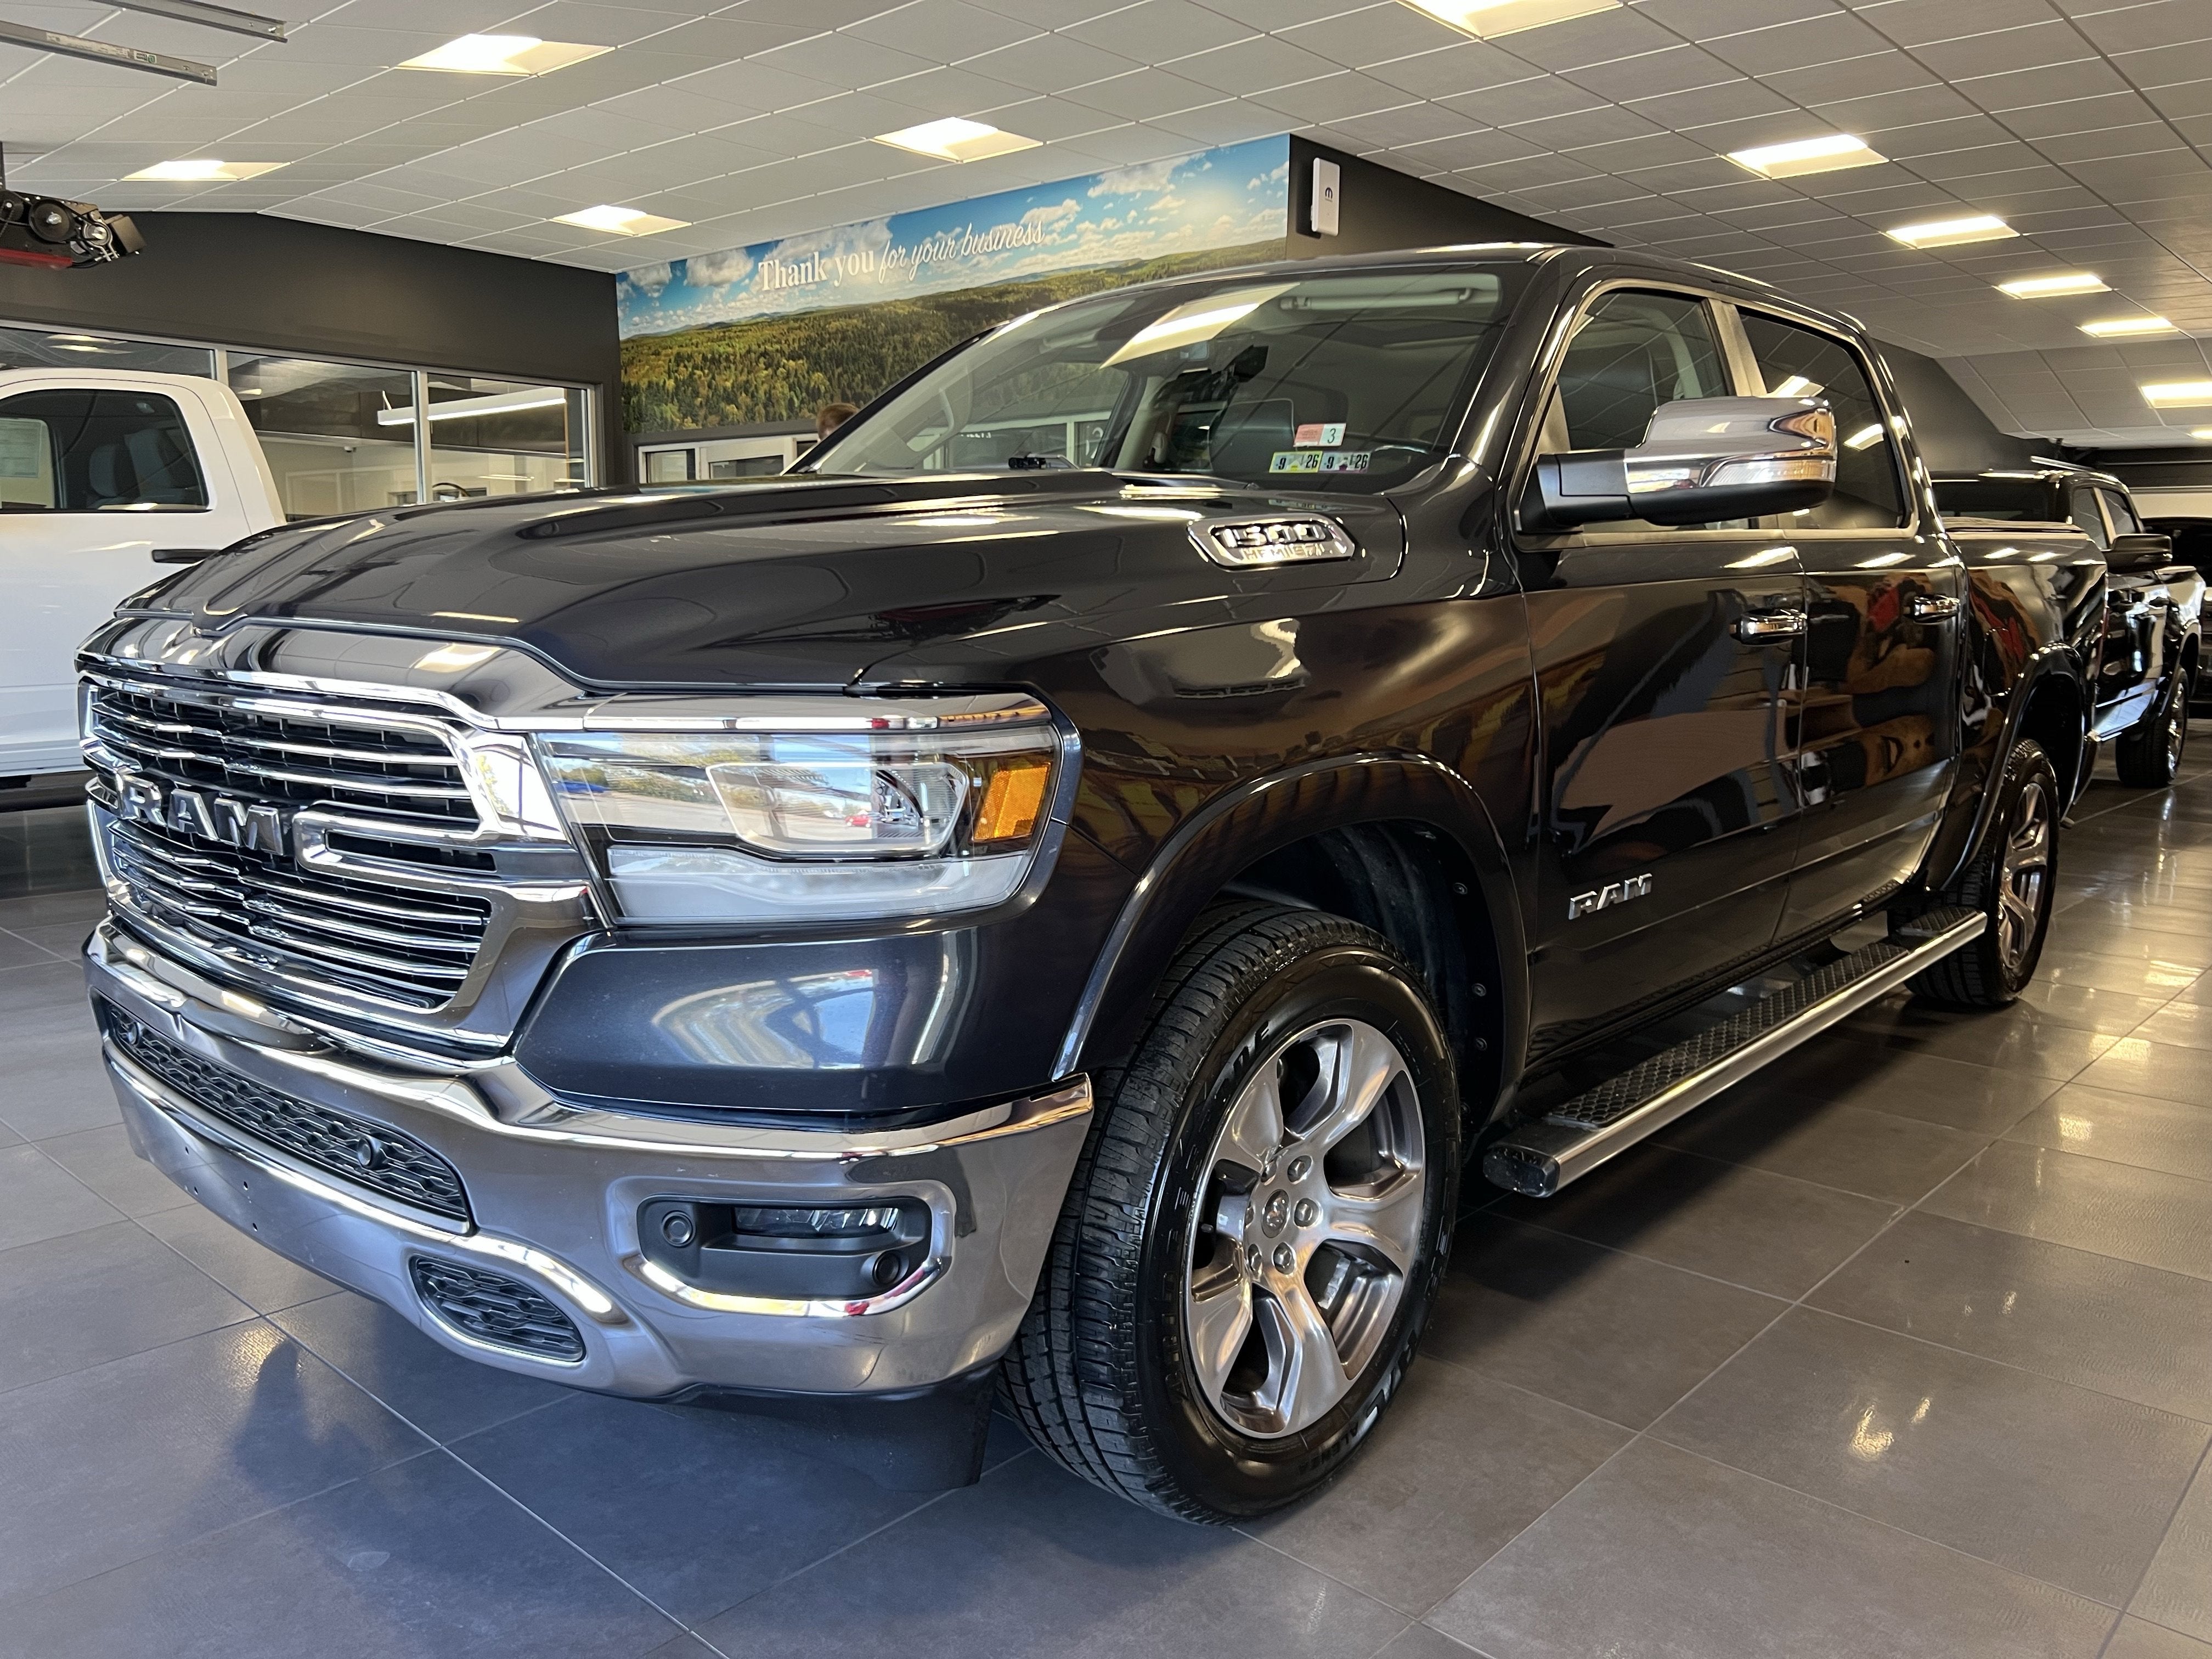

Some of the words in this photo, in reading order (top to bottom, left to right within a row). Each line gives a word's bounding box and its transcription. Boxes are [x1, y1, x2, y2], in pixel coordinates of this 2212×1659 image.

[758, 251, 828, 291] Thank
[833, 246, 874, 287] you
[878, 239, 907, 284] for
[909, 236, 957, 281] your
[960, 221, 1046, 257] business
[1327, 428, 1336, 444] 3
[1305, 454, 1319, 469] 26
[1354, 454, 1368, 470] 26
[1221, 524, 1326, 548] 1500
[116, 770, 284, 856] RAM
[1568, 873, 1652, 920] RAM
